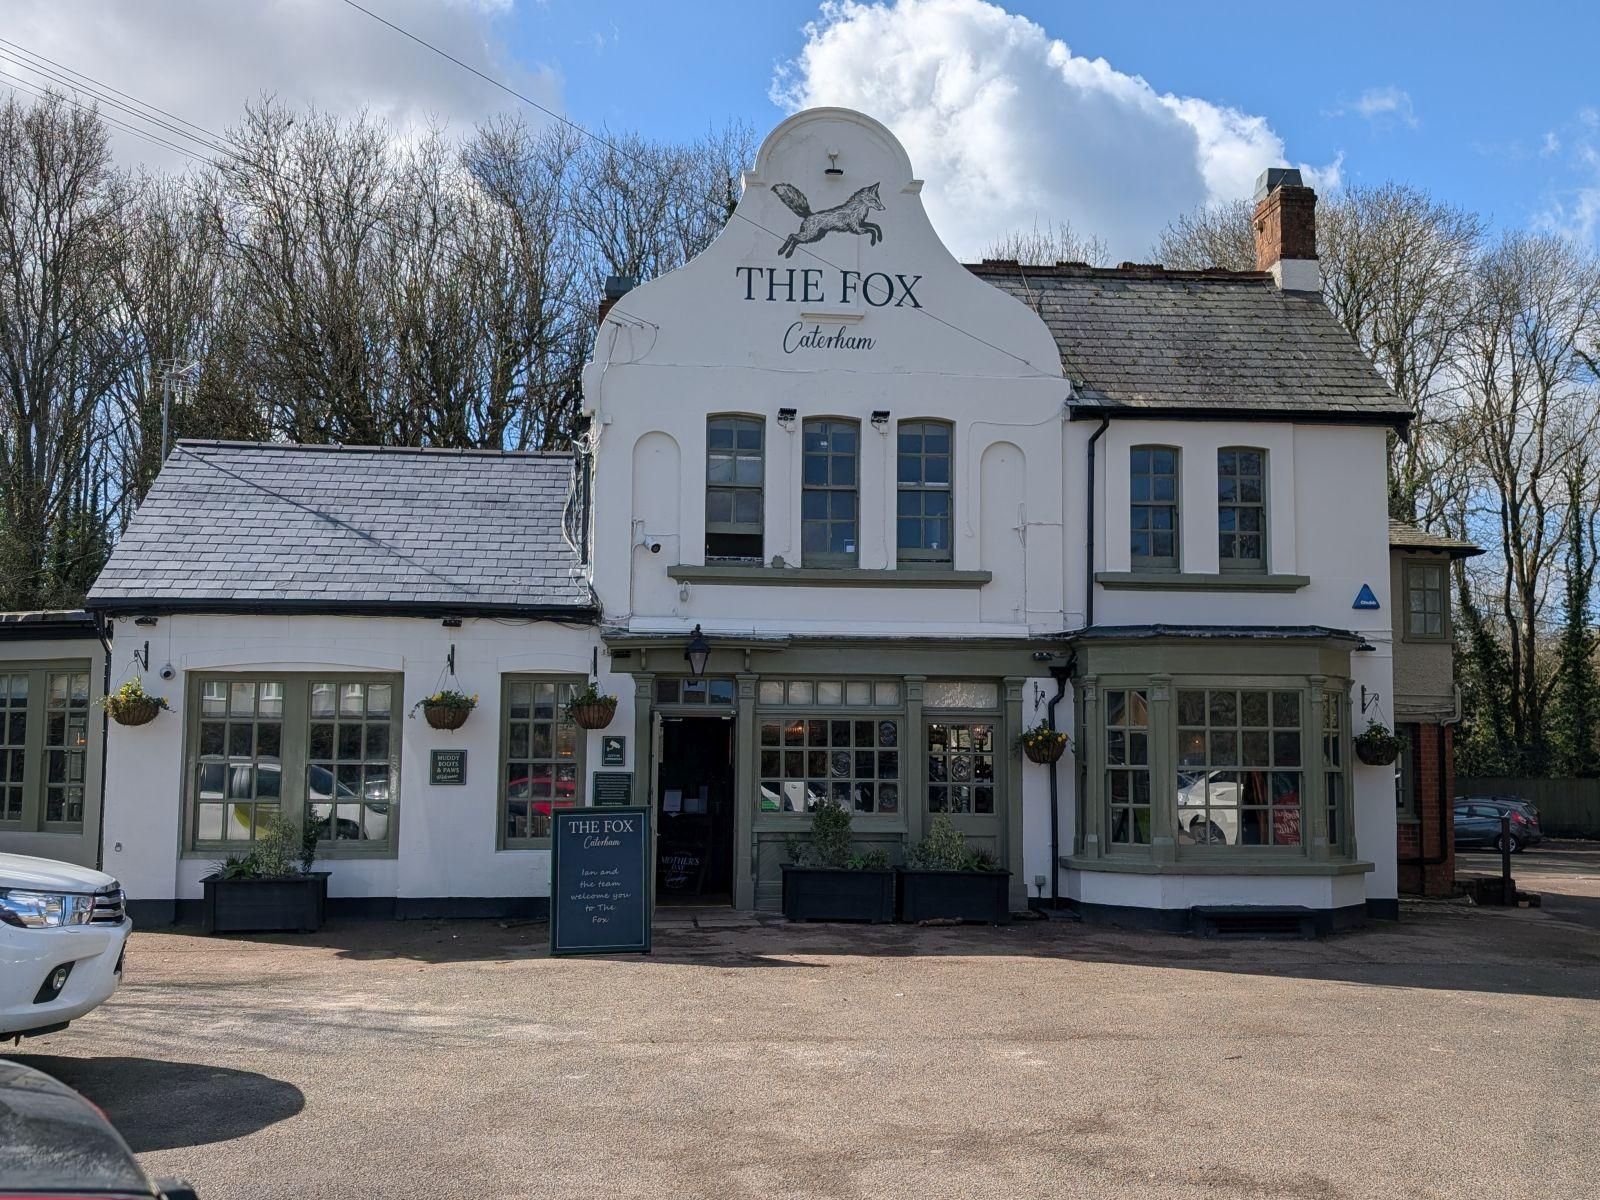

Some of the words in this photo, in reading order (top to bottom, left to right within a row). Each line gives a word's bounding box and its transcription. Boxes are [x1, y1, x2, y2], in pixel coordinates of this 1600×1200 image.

[736, 266, 825, 303] THE
[839, 270, 923, 309] FOX
[782, 321, 877, 354] Caterham
[569, 820, 600, 834] THE
[604, 819, 634, 833] FOX
[583, 835, 621, 849] Caterham
[600, 867, 619, 875] and
[580, 880, 596, 889] the
[570, 892, 610, 901] welcome
[613, 892, 631, 900] you
[585, 904, 596, 912] to
[597, 903, 617, 912] The
[592, 915, 609, 923] Fox
